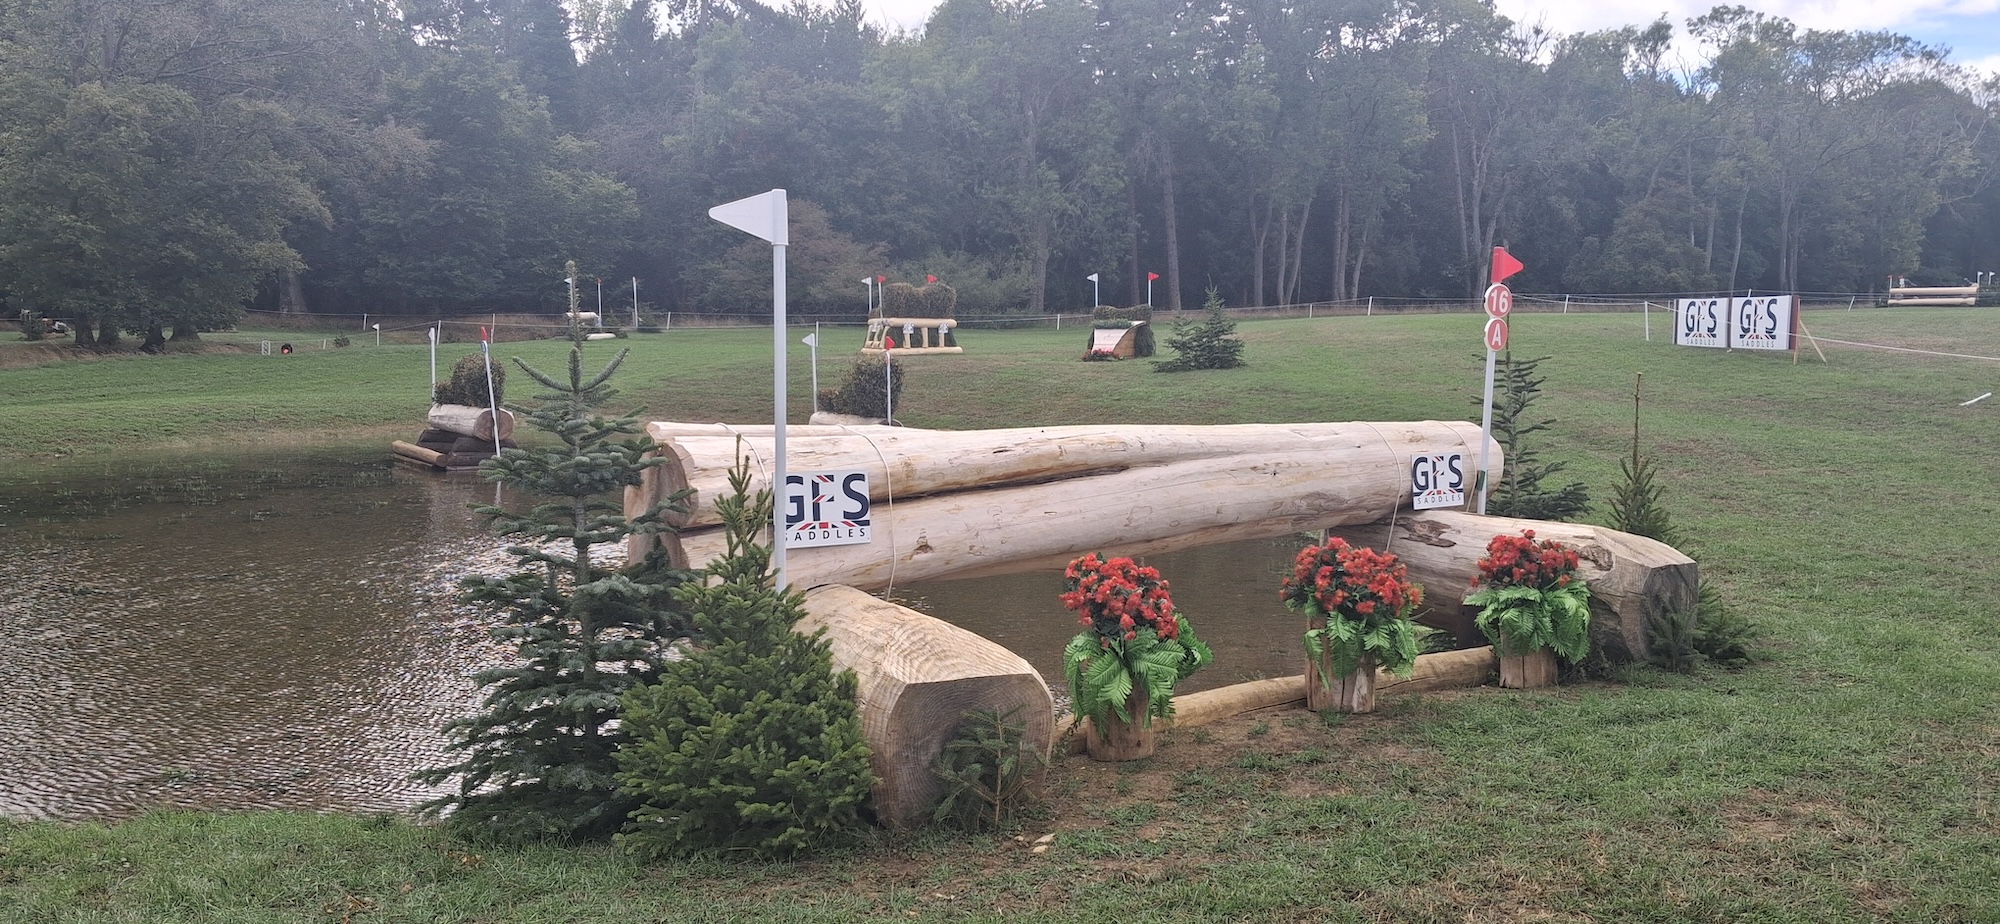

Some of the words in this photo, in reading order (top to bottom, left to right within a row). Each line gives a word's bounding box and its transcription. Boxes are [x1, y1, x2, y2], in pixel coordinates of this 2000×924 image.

[1490, 289, 1509, 313] 16
[1685, 300, 1717, 333] GFS
[1739, 298, 1777, 334] GFS
[1491, 323, 1502, 346] A
[1741, 339, 1775, 348] SADDLES
[1412, 454, 1463, 491] GFS
[1417, 494, 1461, 505] SADDLES
[785, 528, 866, 542] ADDLES
